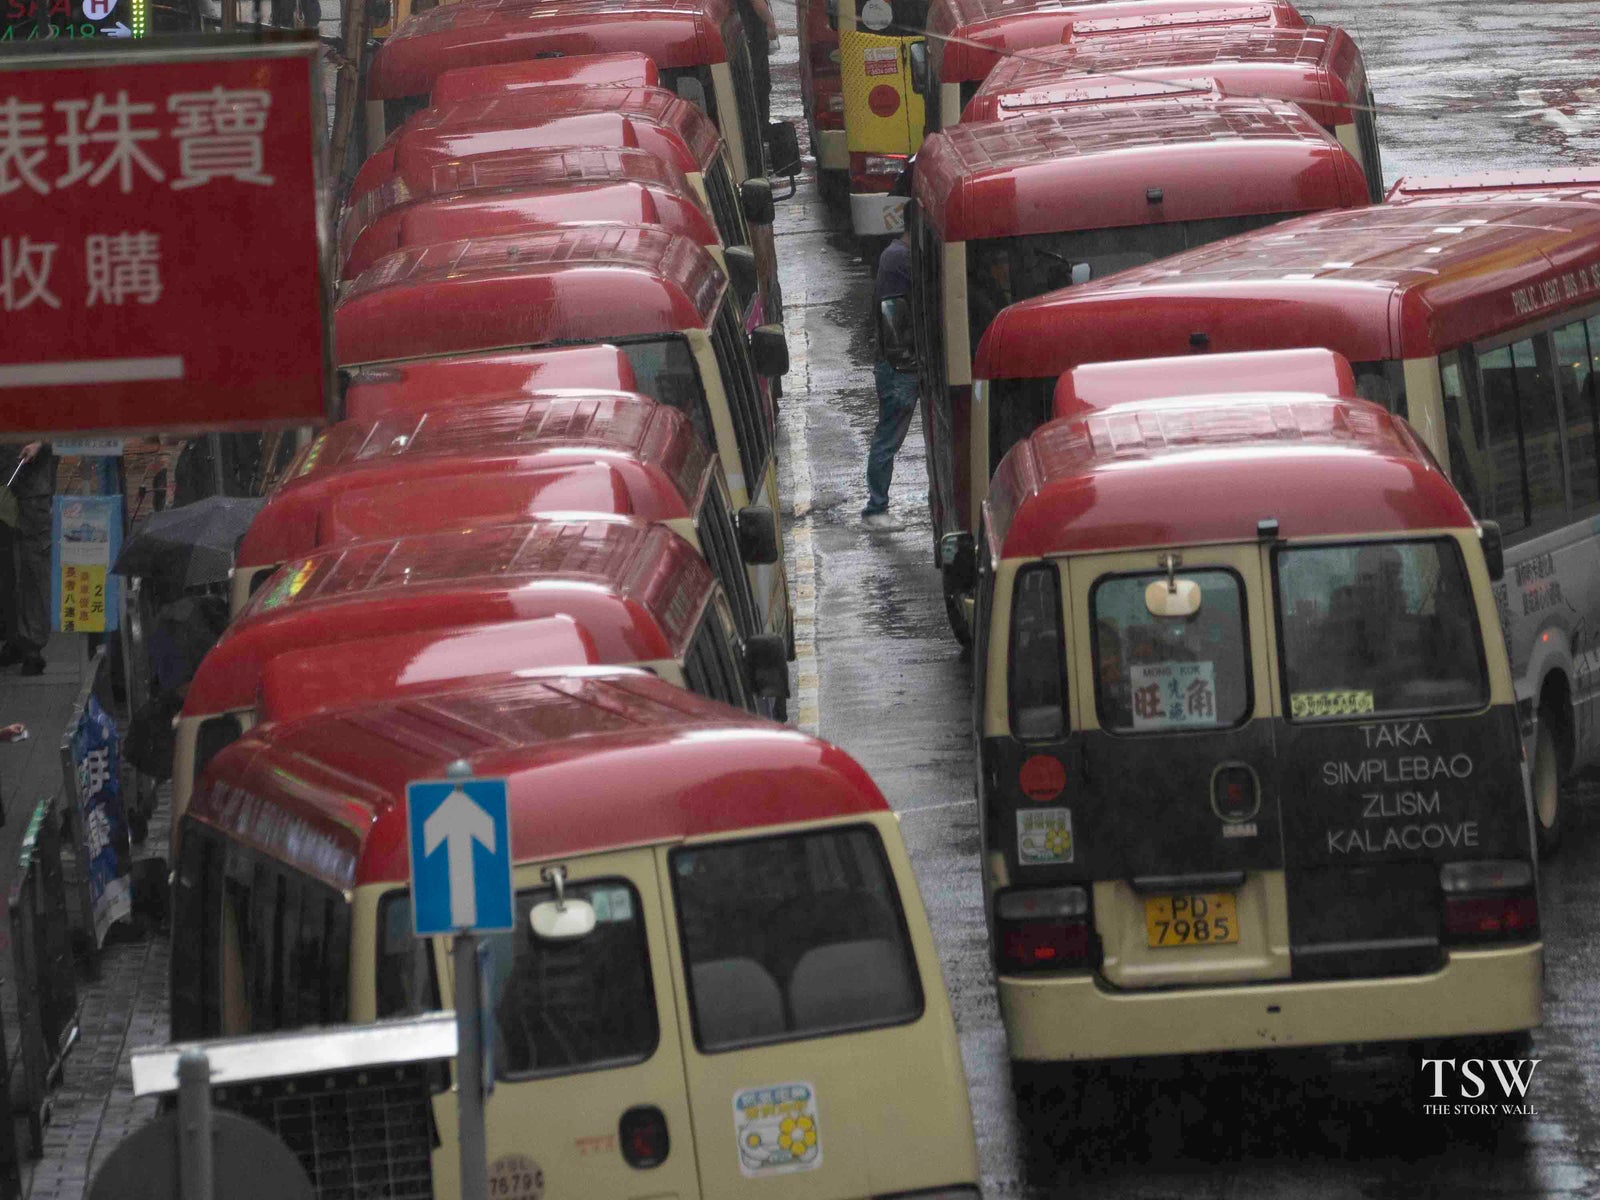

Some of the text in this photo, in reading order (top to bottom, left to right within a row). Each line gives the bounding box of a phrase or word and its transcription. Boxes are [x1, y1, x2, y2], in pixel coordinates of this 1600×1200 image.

[1511, 286, 1538, 316] PUBLIC
[1538, 277, 1561, 308] LIGHT
[1562, 272, 1579, 299] BUS
[1142, 664, 1201, 678] MONG KOK
[1358, 722, 1432, 749] TAKA
[1322, 753, 1473, 786] SIMPLEBAO
[1362, 790, 1440, 818] ZLISM
[1327, 821, 1479, 855] KALACOVE
[1170, 895, 1209, 919] PD
[1153, 917, 1231, 945] 7985
